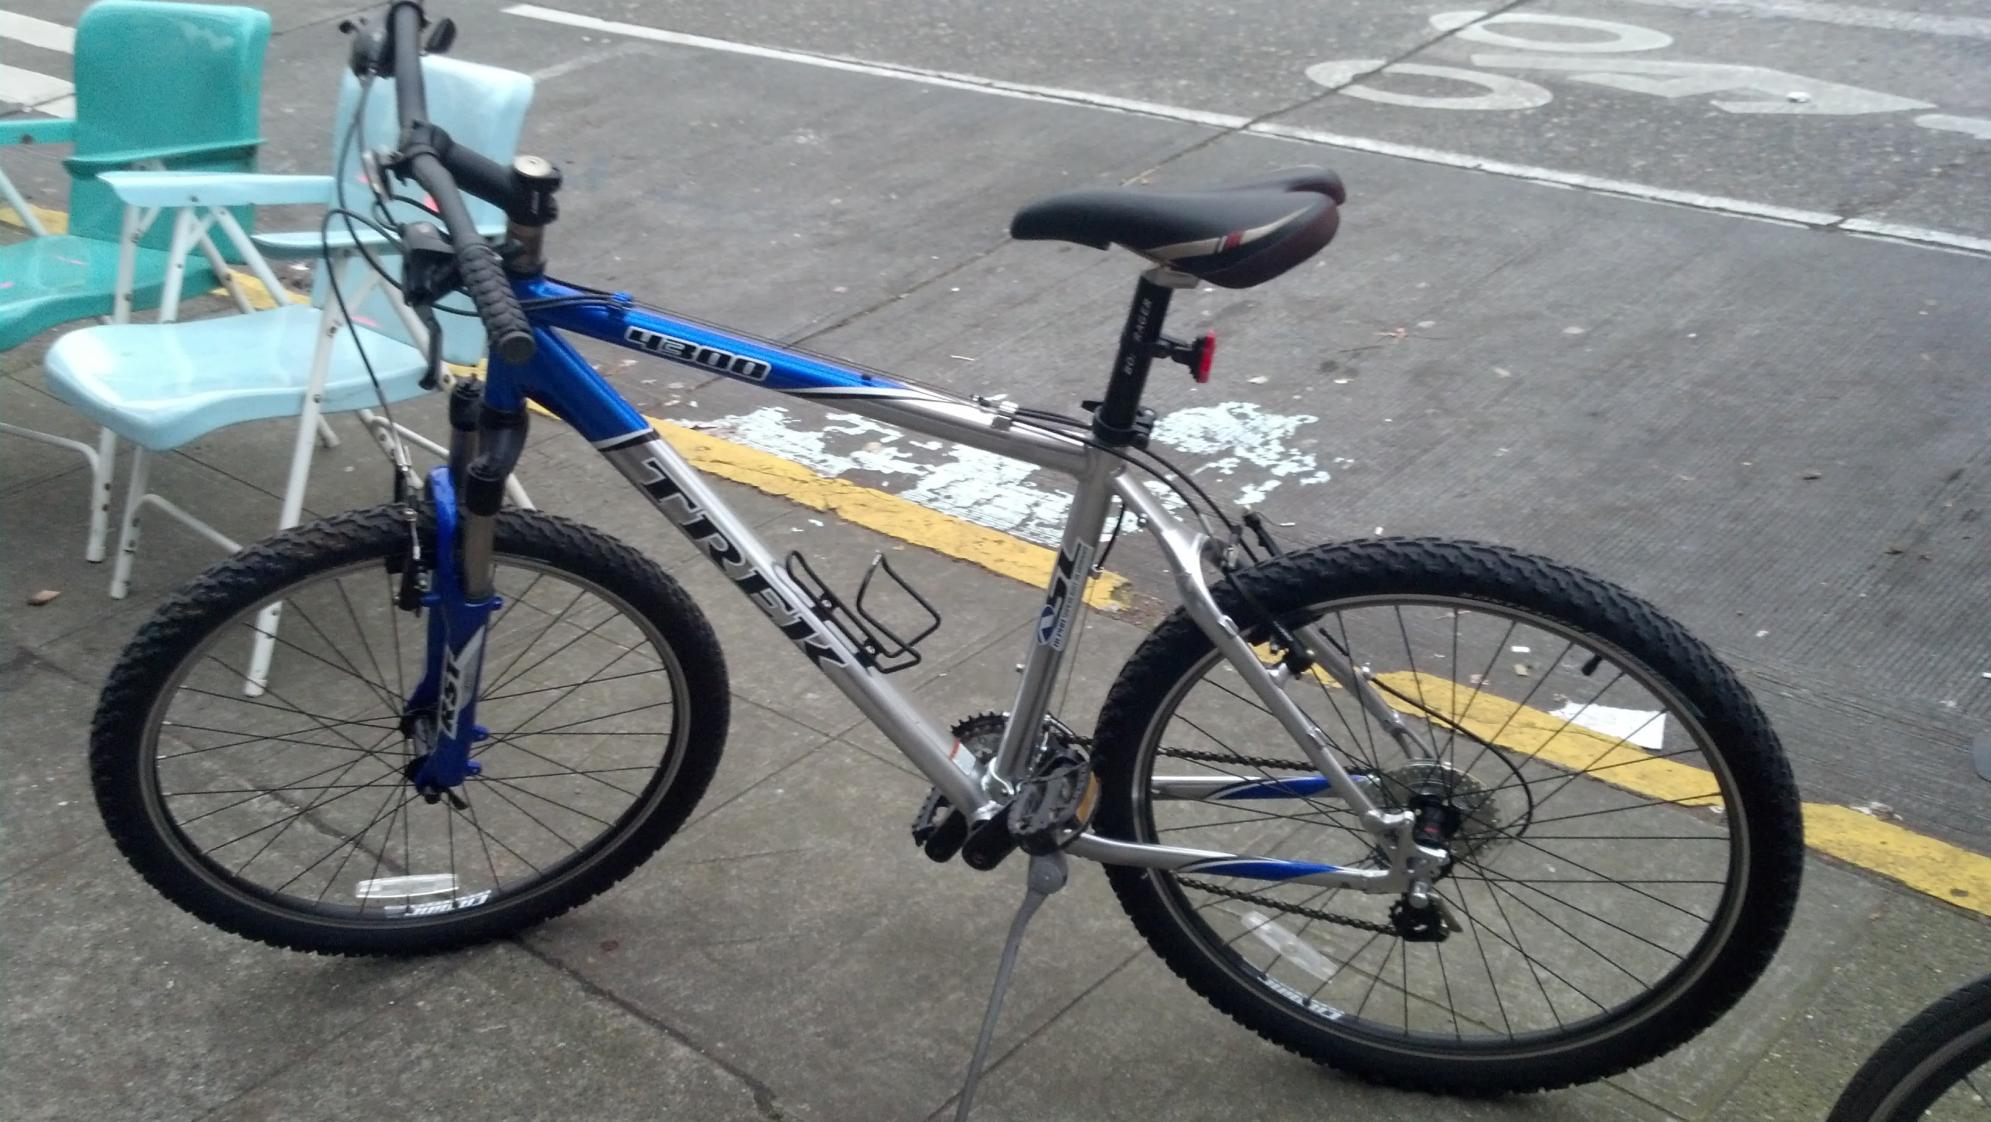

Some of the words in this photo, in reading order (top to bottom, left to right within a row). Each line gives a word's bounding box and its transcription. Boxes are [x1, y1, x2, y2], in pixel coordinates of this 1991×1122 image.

[625, 325, 772, 381] 4300
[1124, 298, 1152, 376] BORAGER
[641, 458, 850, 669] TREK
[441, 660, 460, 735] RST
